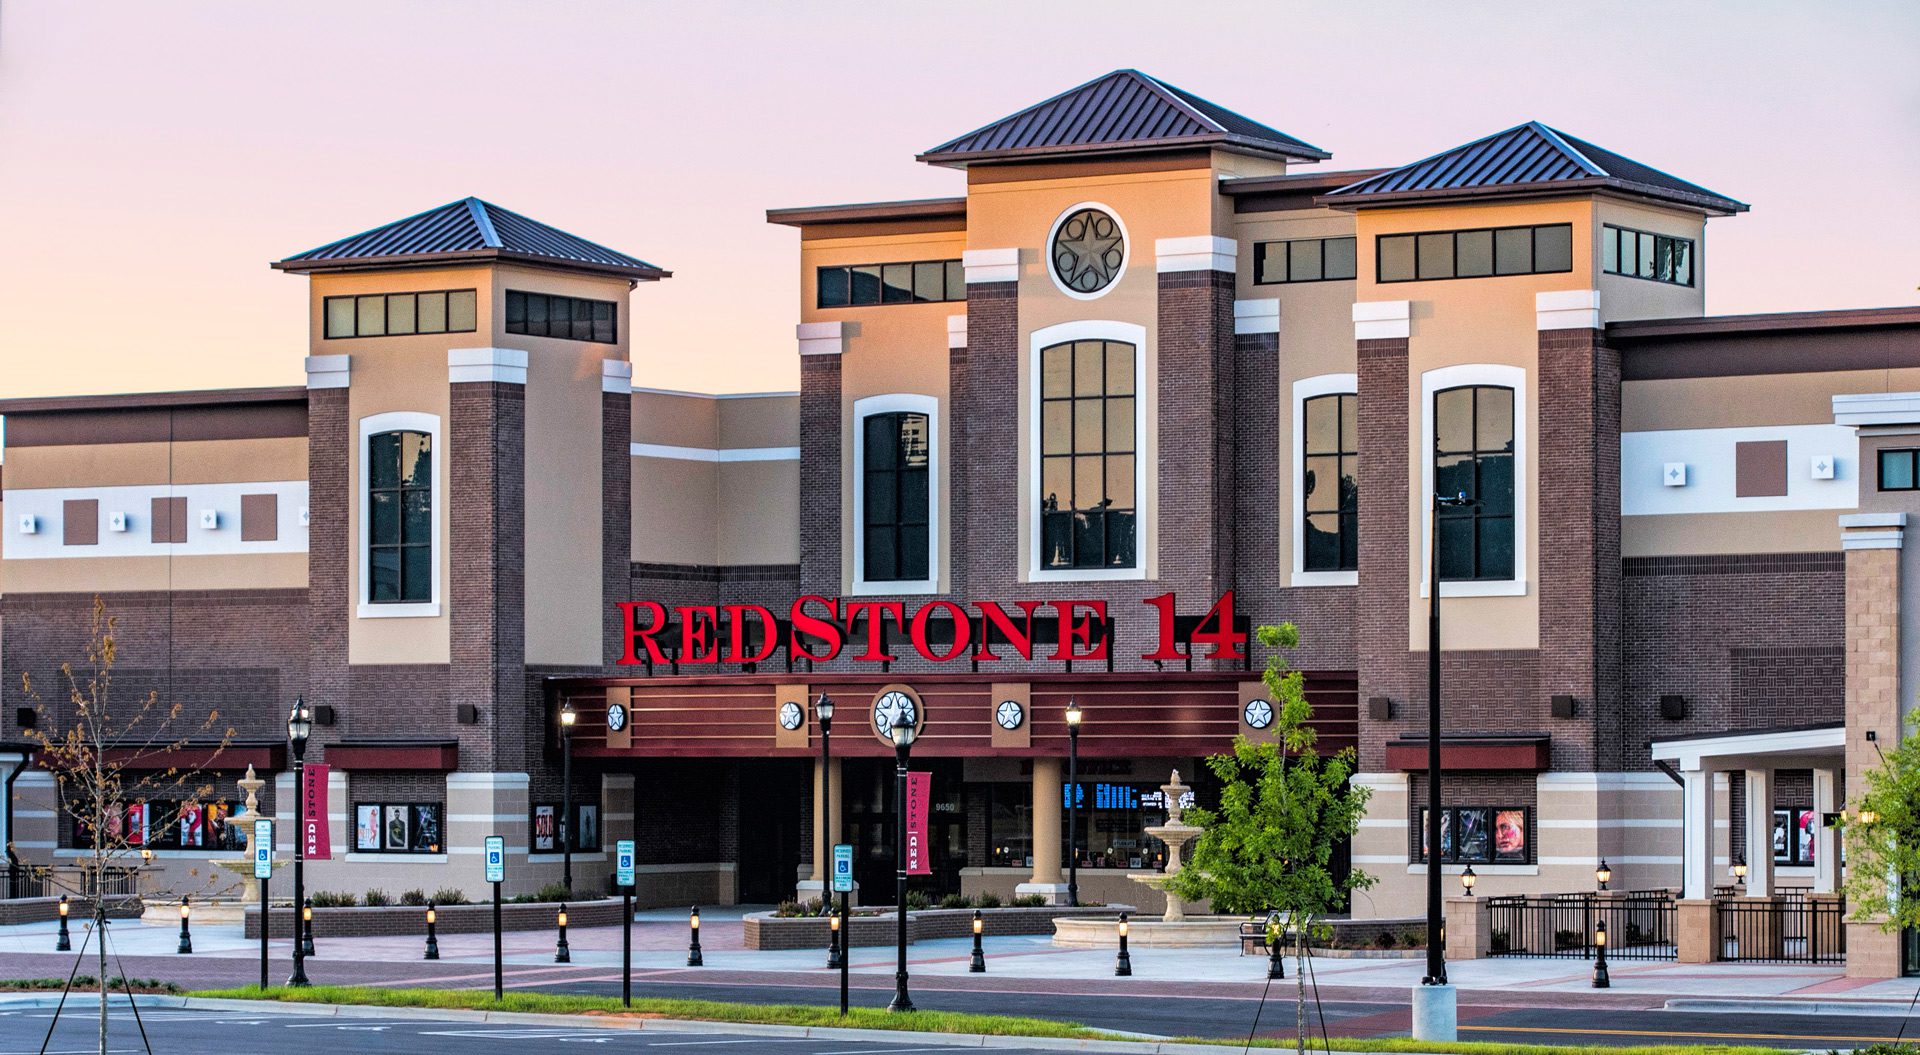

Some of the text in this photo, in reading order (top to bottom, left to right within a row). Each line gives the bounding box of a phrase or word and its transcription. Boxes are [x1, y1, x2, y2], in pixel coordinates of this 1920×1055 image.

[1141, 589, 1247, 660] 14
[308, 769, 316, 855] RED STONE
[935, 802, 955, 811] 9650
